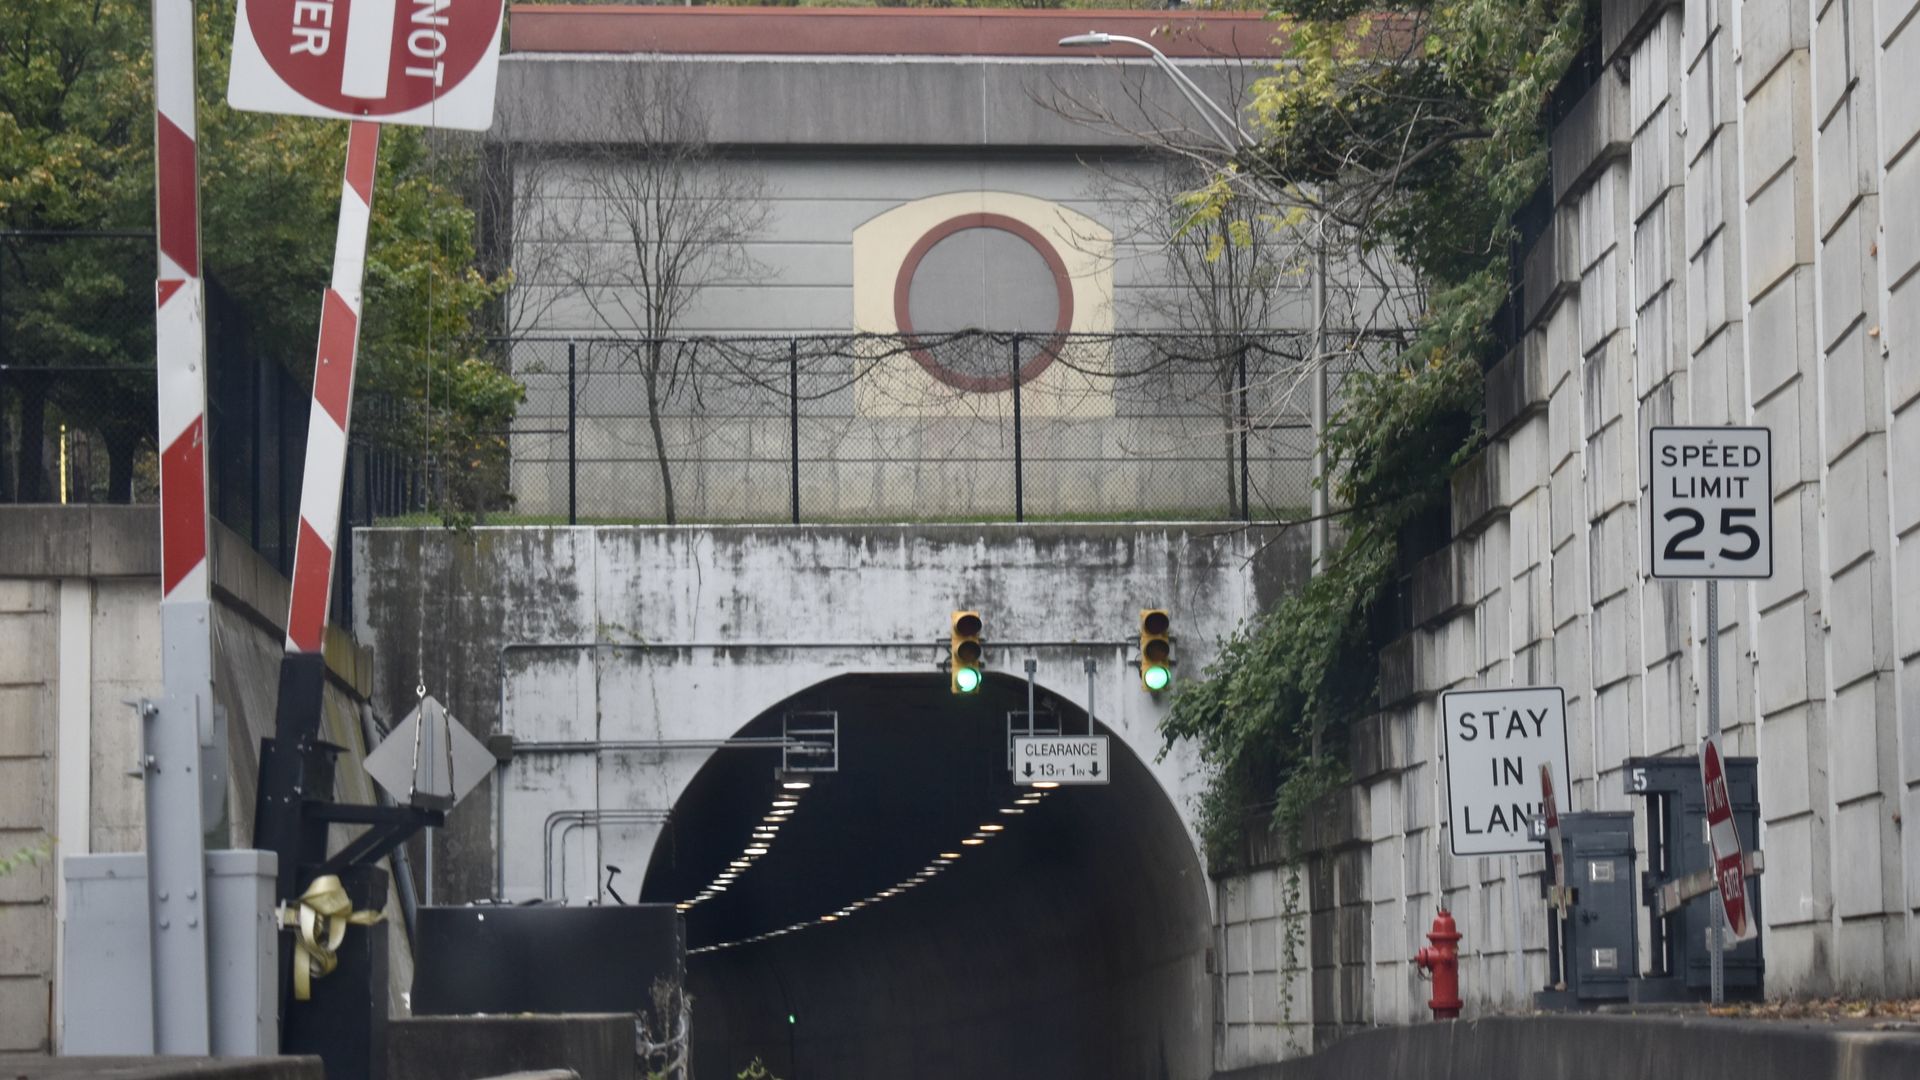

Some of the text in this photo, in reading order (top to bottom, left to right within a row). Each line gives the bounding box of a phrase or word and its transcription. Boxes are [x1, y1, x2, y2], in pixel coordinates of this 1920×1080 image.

[290, 0, 334, 56] ER
[405, 0, 451, 87] NOT
[1661, 445, 1761, 468] SPEED
[1672, 476, 1749, 499] LIMIT
[1663, 507, 1760, 561] 25
[1459, 708, 1549, 742] STAY
[1025, 743, 1098, 757] CLEARANCE
[1492, 756, 1524, 787] IN
[1632, 768, 1648, 791] 5
[1464, 802, 1544, 835] LAN
[1723, 866, 1742, 901] ENTER
